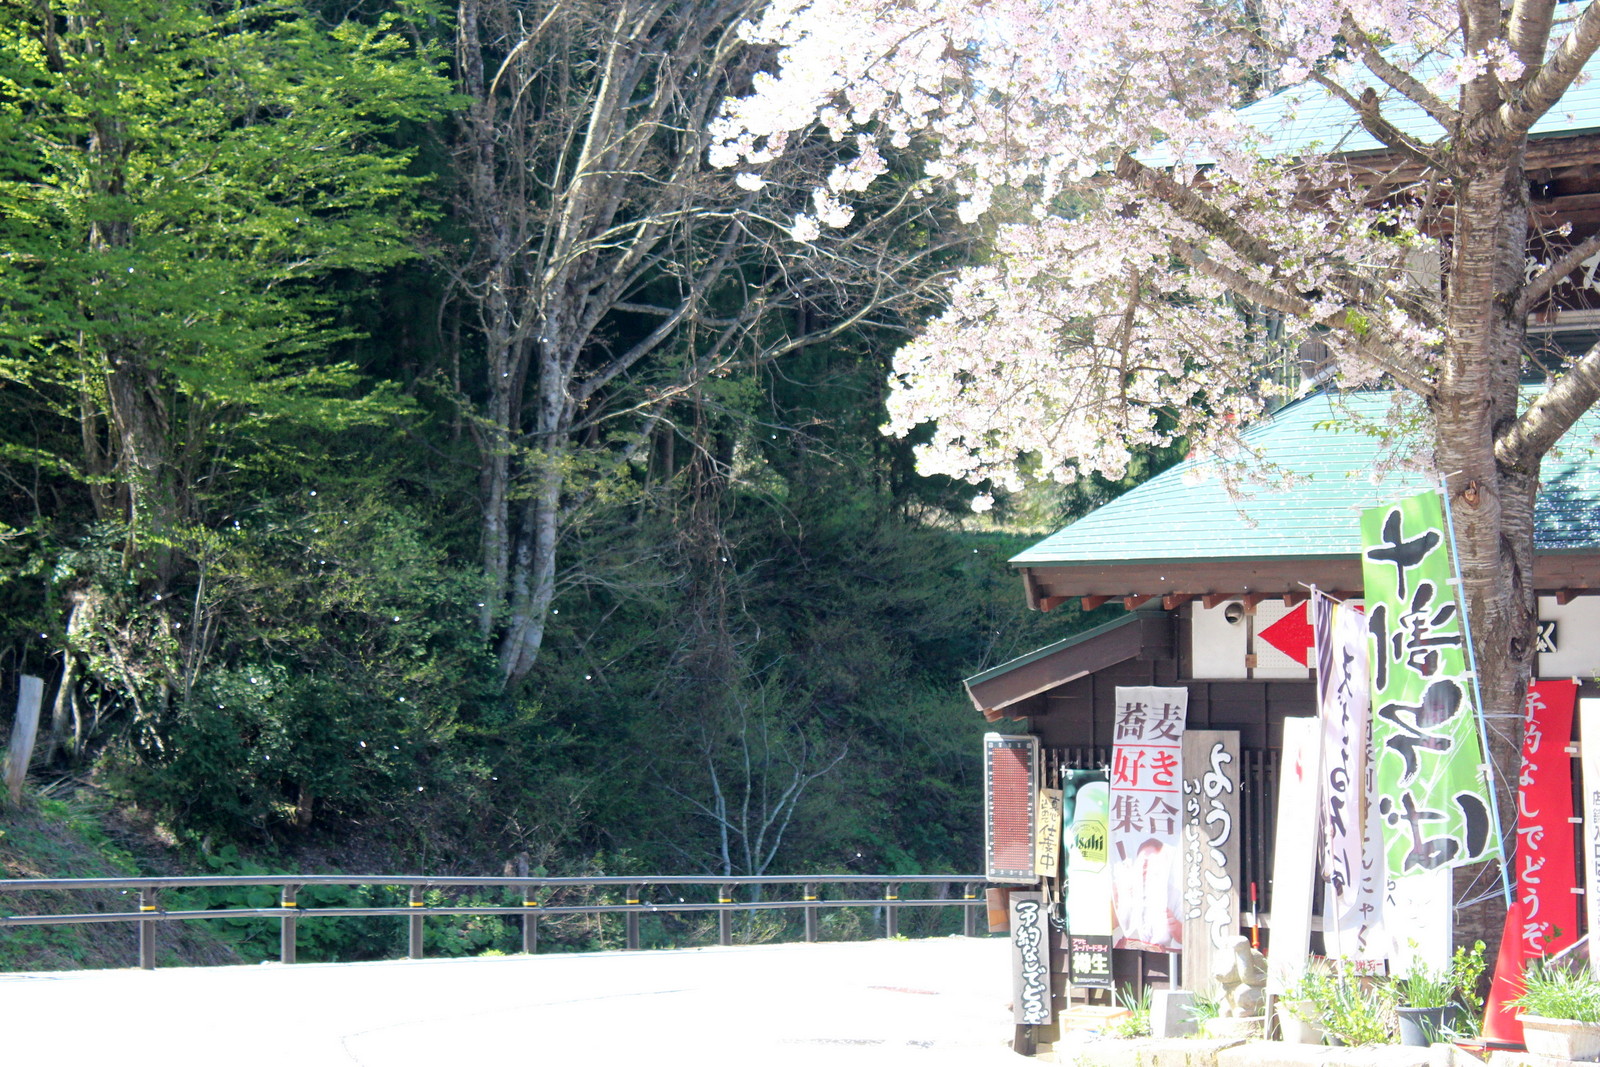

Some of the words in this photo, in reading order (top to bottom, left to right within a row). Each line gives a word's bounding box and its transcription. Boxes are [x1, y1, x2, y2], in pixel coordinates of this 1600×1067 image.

[1116, 702, 1183, 742] 蕎麦
[1113, 748, 1179, 787] 好き
[1111, 794, 1180, 836] 集合
[1203, 743, 1233, 949] ようこそ
[1015, 900, 1049, 1024] 予約なしでどうぞ
[1072, 944, 1108, 952] スーパードライ
